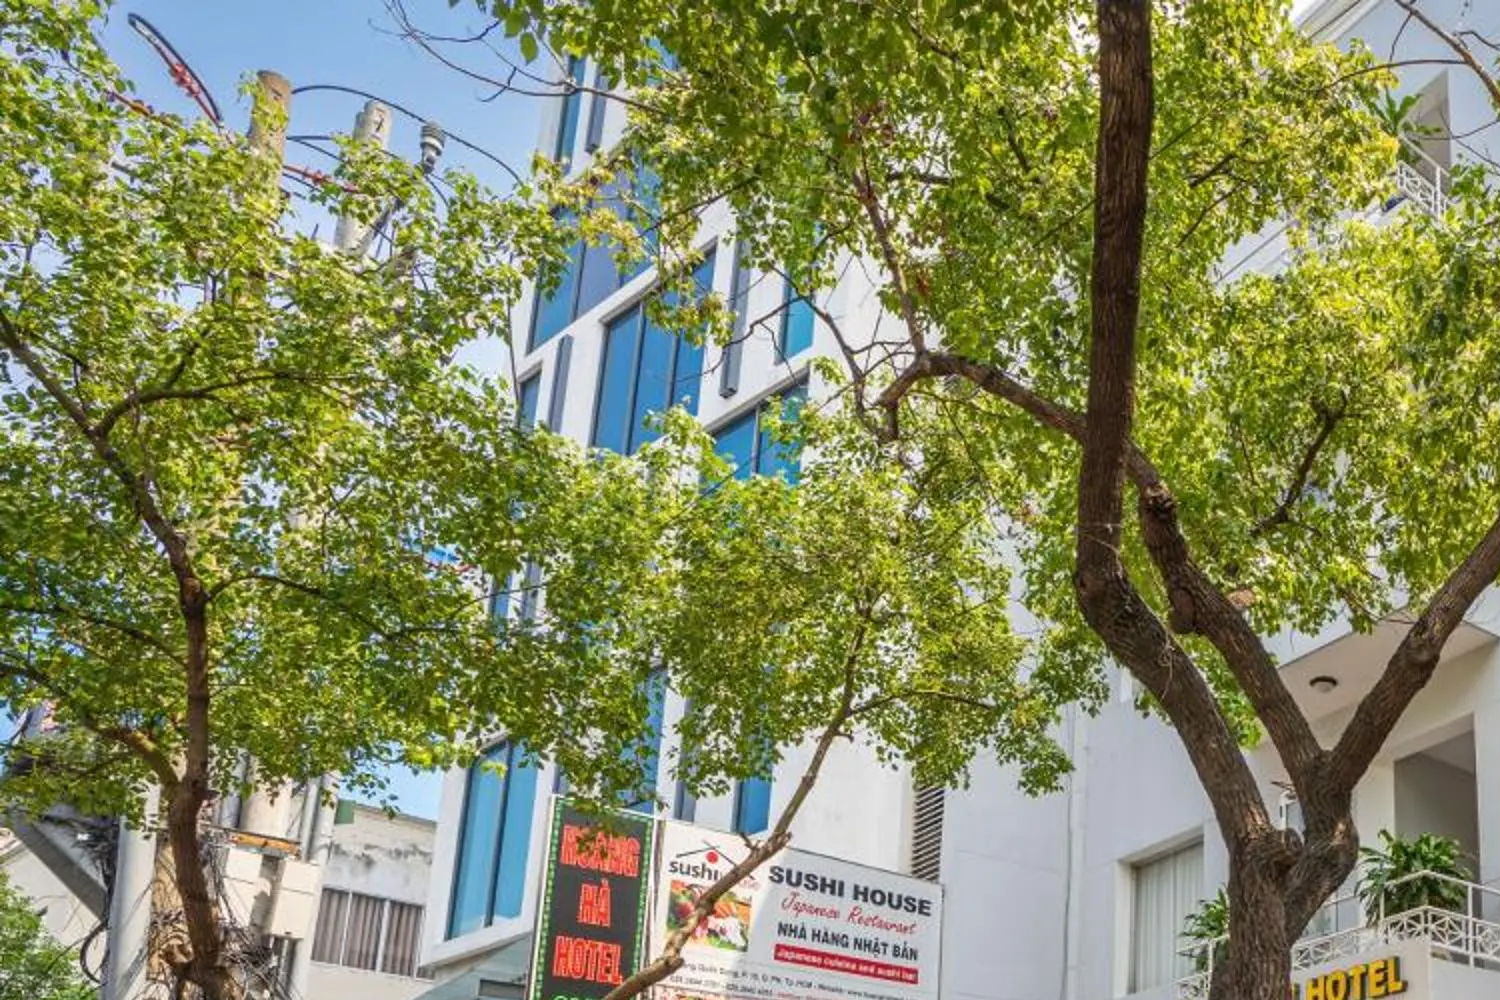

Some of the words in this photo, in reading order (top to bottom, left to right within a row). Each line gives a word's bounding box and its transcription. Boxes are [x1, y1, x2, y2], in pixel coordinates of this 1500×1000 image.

[768, 866, 845, 897] SUSHI
[853, 884, 932, 916] HOUSE
[781, 892, 840, 919] Japanese
[848, 905, 917, 935] Restaurant
[553, 936, 623, 985] HOTEL
[777, 921, 807, 940] NHÀ
[811, 927, 849, 948] HÀNG
[853, 937, 888, 958] NHẬT
[892, 941, 918, 961] BẢN
